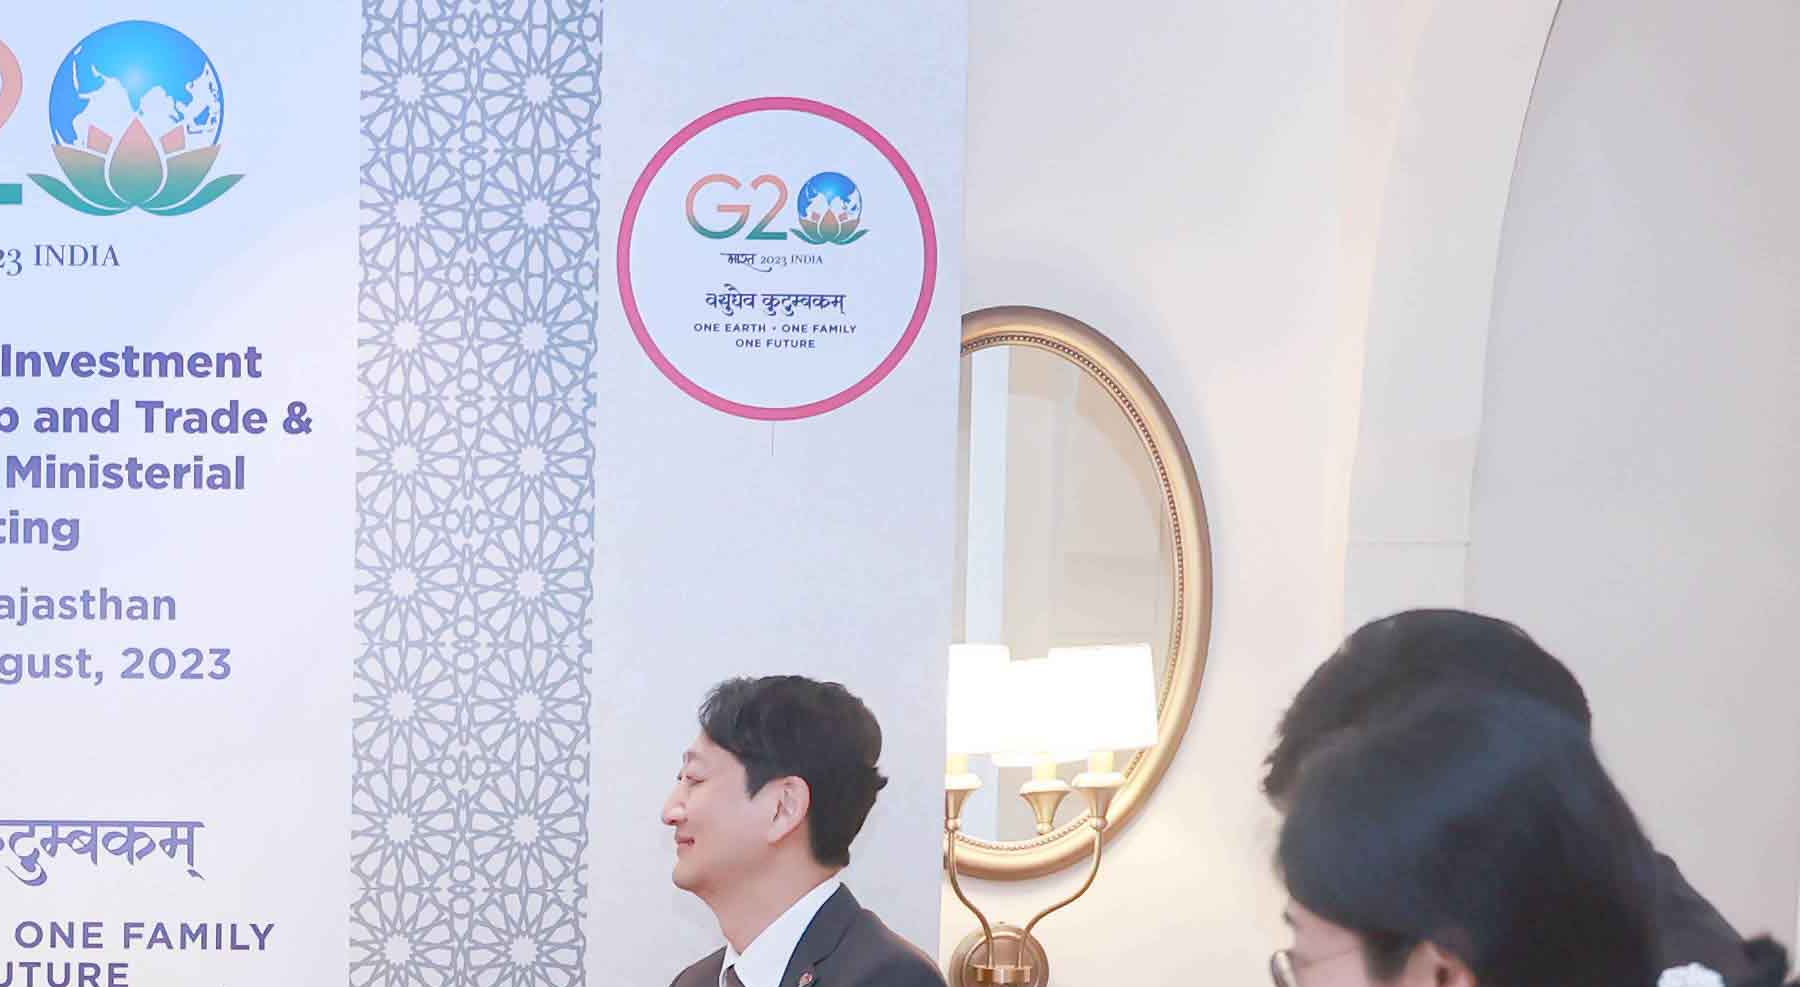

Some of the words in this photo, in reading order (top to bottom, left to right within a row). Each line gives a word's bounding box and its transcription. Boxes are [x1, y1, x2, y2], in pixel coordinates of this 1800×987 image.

[685, 171, 870, 245] G20
[34, 244, 120, 267] INDIA
[791, 255, 824, 265] INDIA
[693, 323, 721, 332] ONE
[724, 323, 767, 333] EARTH
[781, 323, 809, 334] ONE
[812, 324, 858, 334] FAMILY
[735, 338, 762, 348] ONE
[766, 338, 816, 349] FUTURE
[1, 343, 263, 379] Investment
[33, 398, 120, 434] and
[135, 399, 268, 435] Trade
[282, 400, 313, 435] &
[6, 454, 246, 490] Ministerial
[120, 647, 232, 680] 2023
[14, 920, 104, 949] ONE
[123, 922, 276, 951] FAMILY
